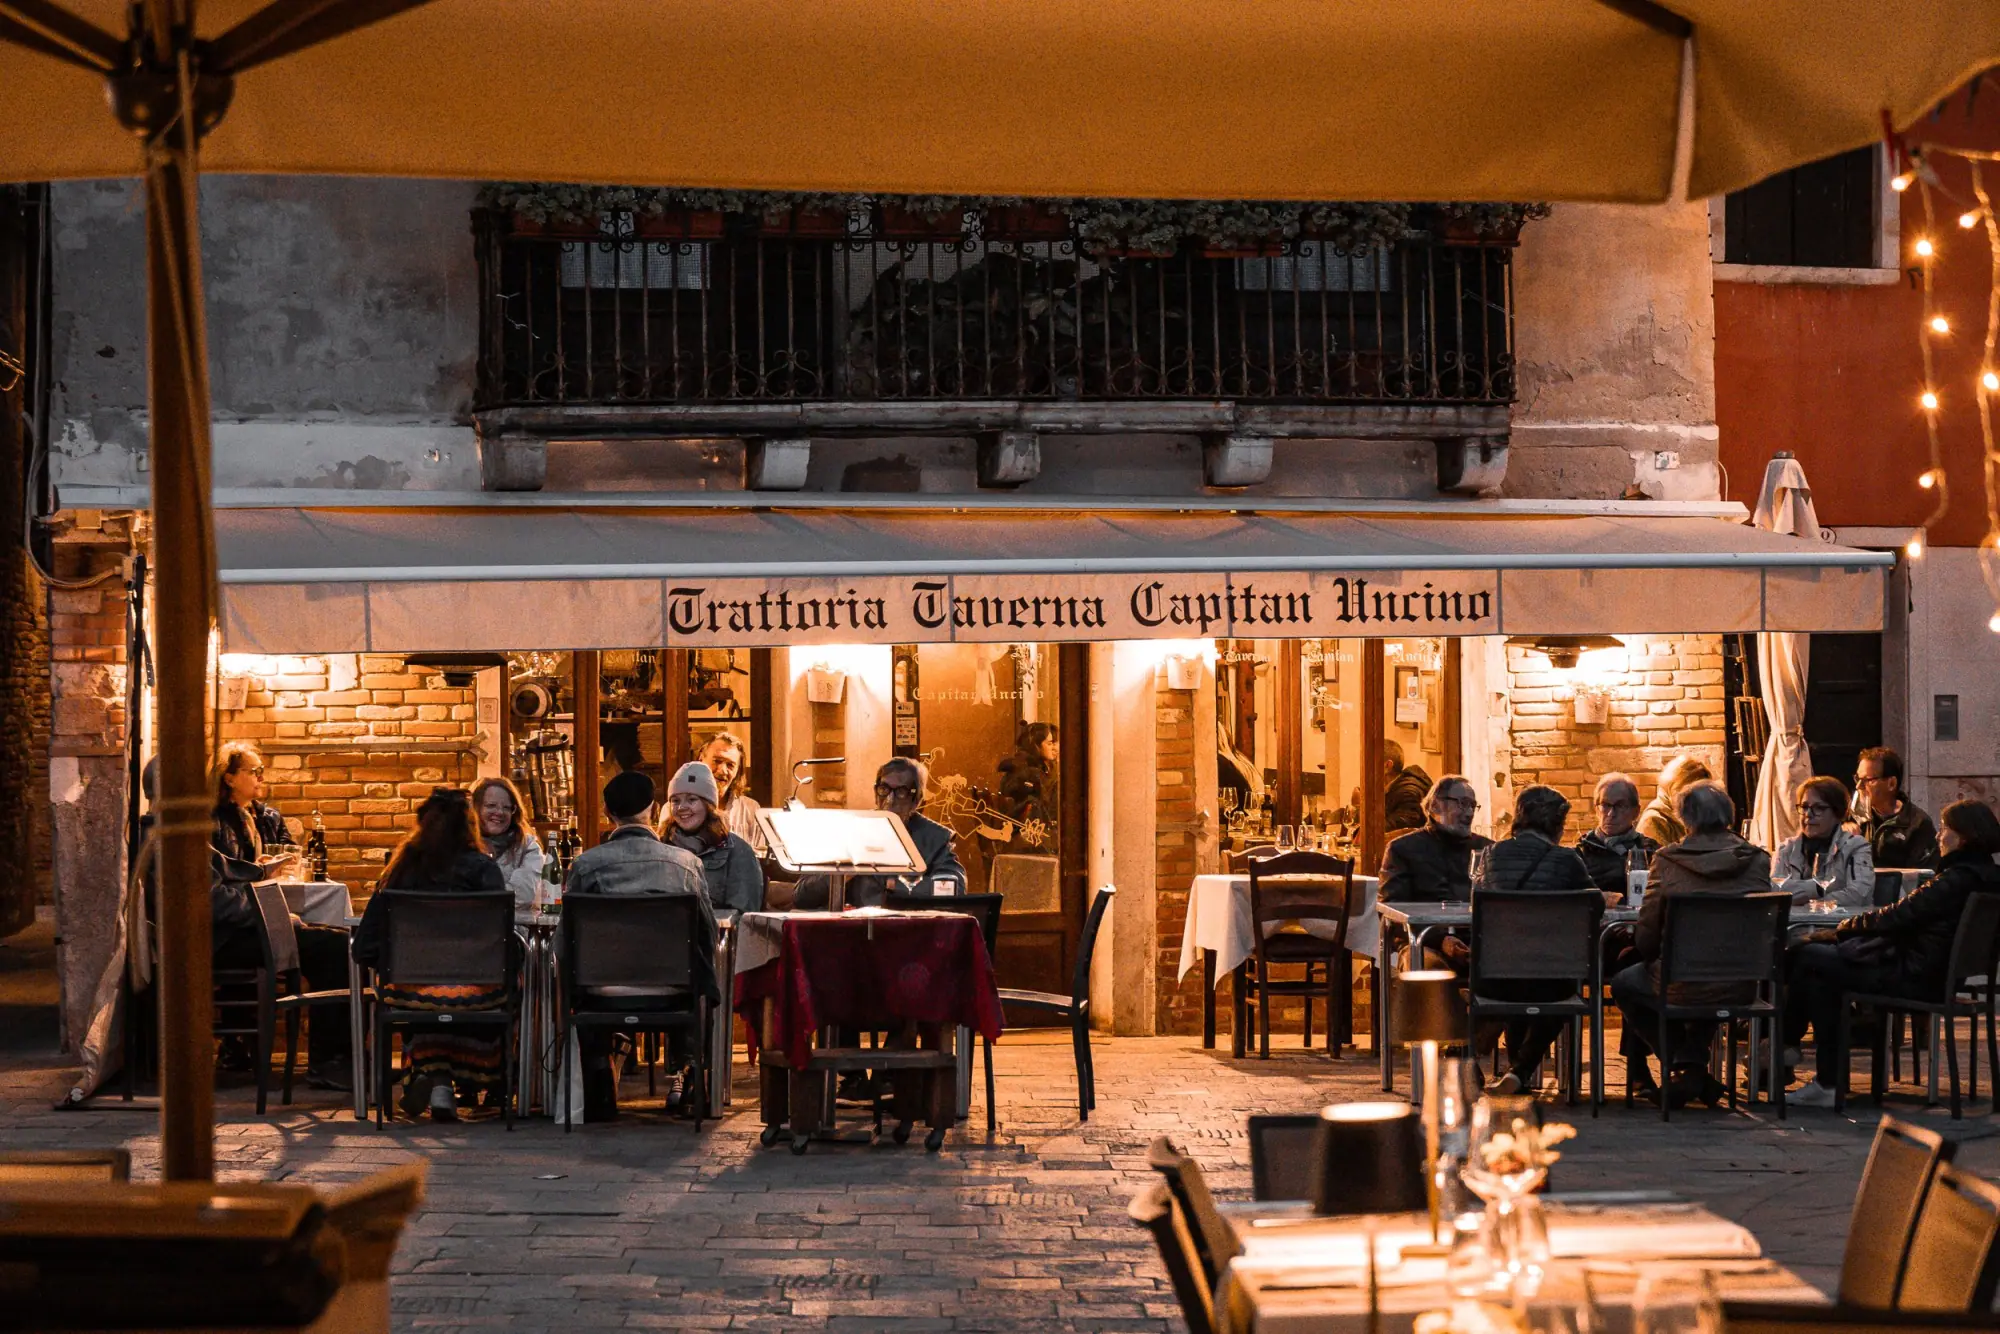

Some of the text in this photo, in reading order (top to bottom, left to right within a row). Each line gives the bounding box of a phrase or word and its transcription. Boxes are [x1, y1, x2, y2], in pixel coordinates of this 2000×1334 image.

[668, 577, 1492, 635] Trattoria Taverna Capitan Uncino
